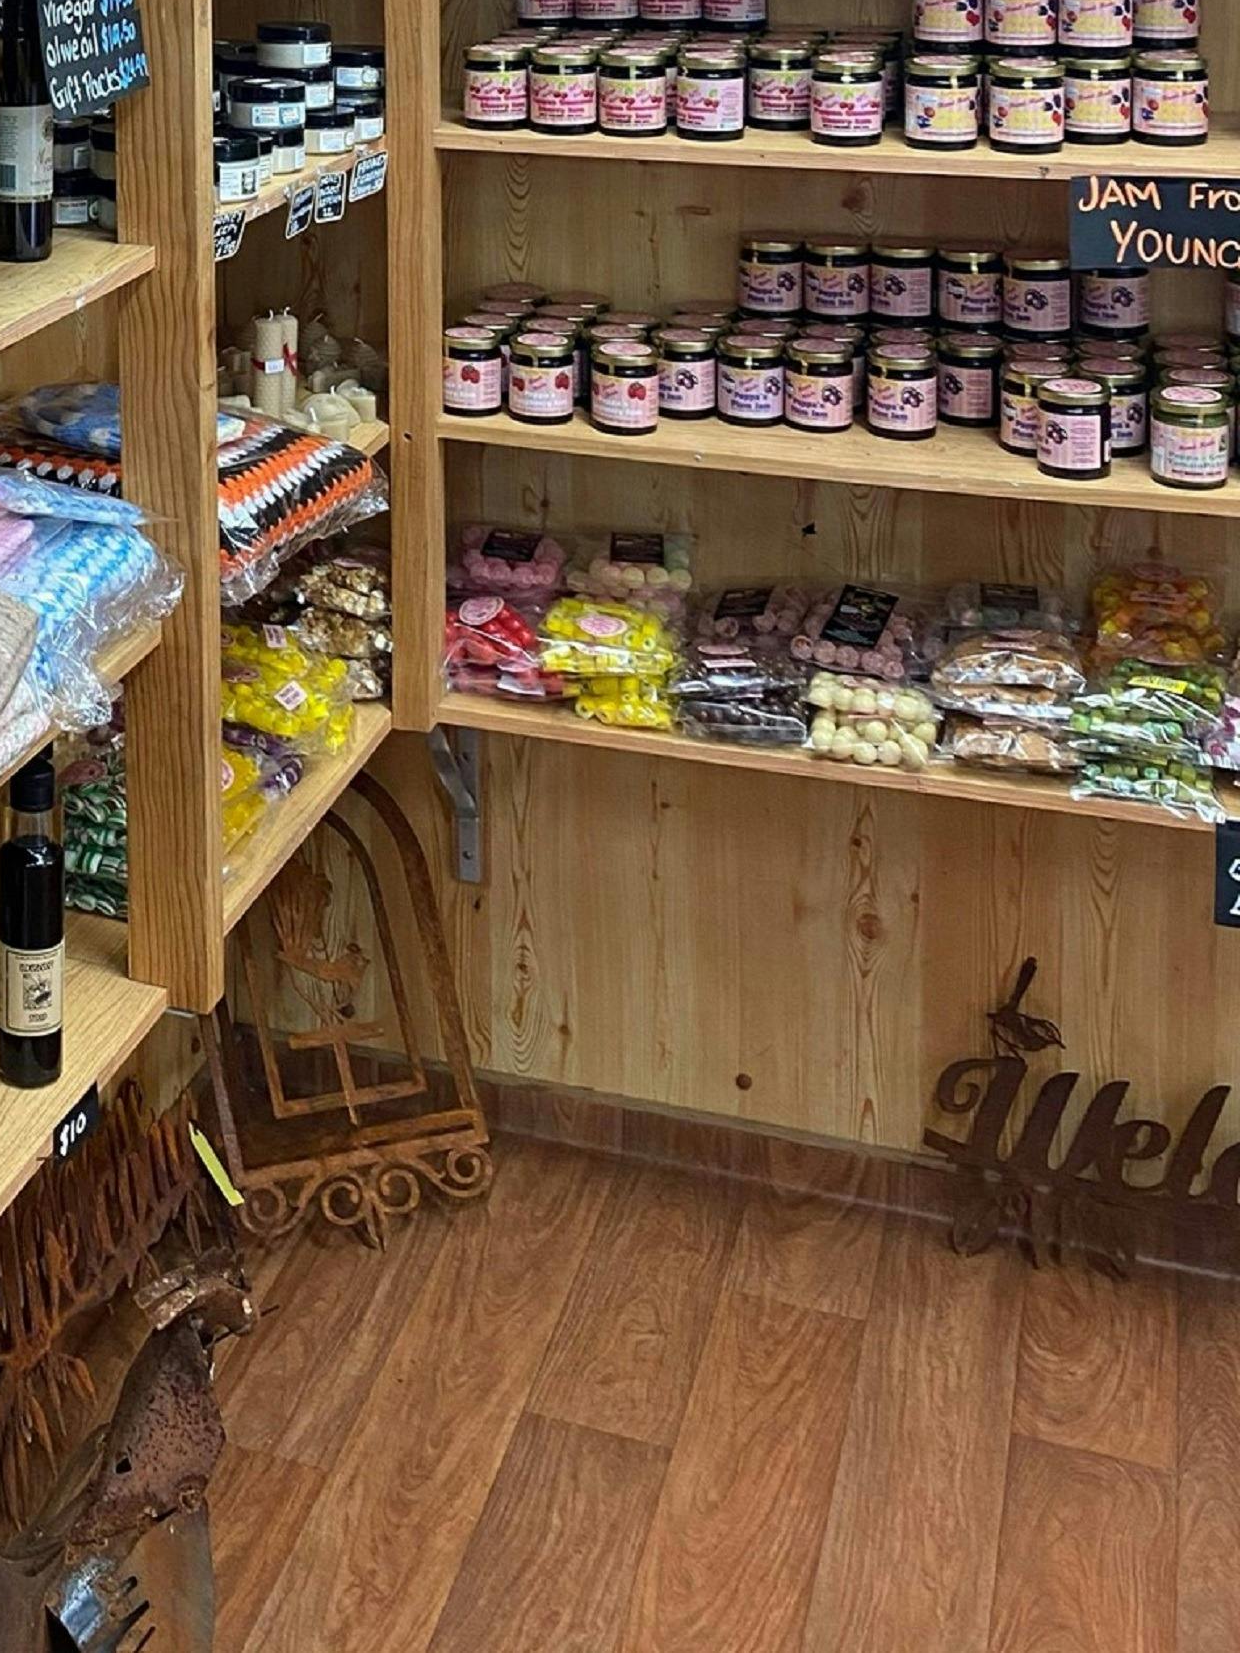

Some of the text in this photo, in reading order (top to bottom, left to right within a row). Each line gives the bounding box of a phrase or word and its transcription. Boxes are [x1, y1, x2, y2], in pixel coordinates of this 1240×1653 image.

[49, 74, 82, 115] Gift
[1078, 175, 1162, 212] JAM
[59, 1112, 87, 1157] $10
